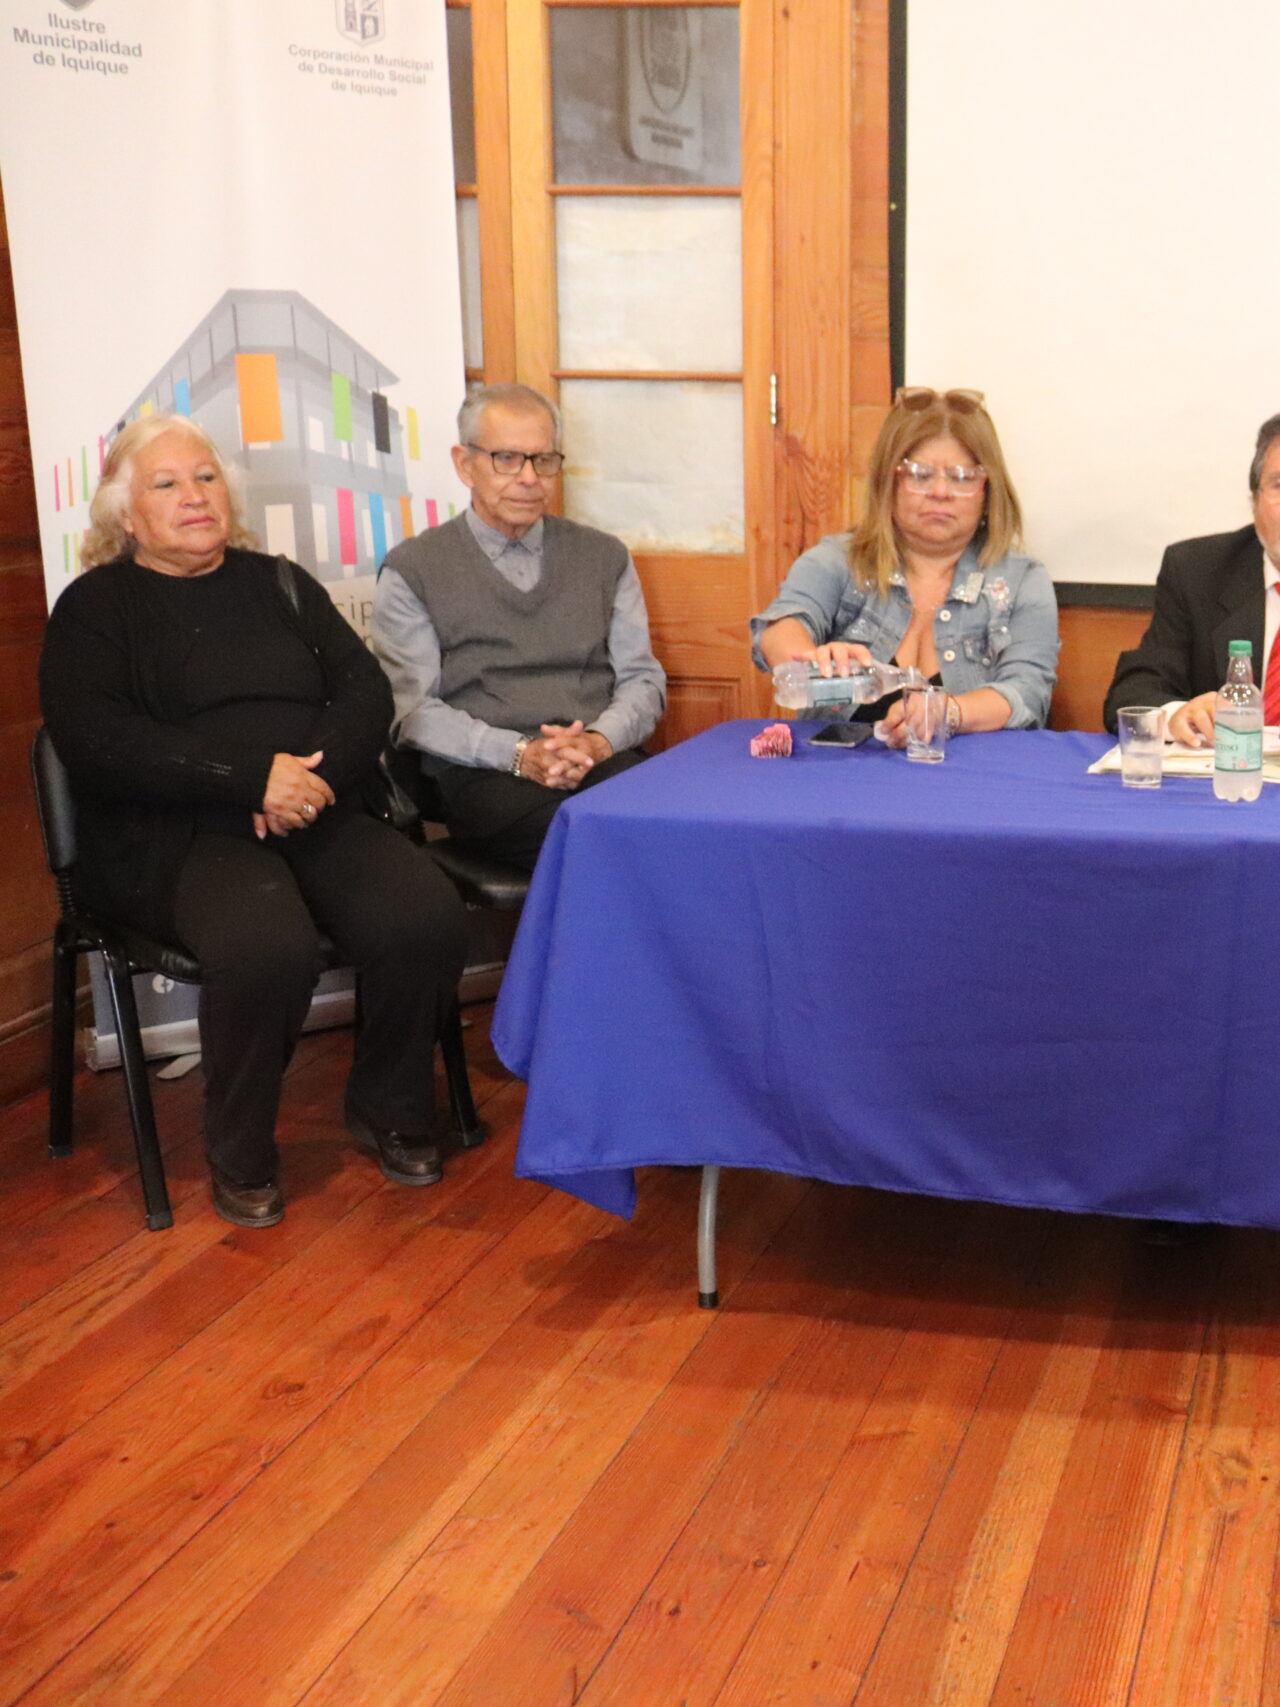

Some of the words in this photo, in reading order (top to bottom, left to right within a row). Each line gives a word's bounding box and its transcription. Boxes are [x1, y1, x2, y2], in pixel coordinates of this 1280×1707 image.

[47, 12, 107, 35] Ilustre
[13, 27, 142, 57] Municipalidad
[32, 50, 56, 67] de
[61, 53, 129, 76] Iquique
[297, 61, 314, 73] de
[318, 62, 385, 81] Desarrollo
[389, 70, 427, 85] Social
[374, 54, 434, 73] Municipal
[331, 80, 347, 92] de
[350, 81, 398, 97] Iquique
